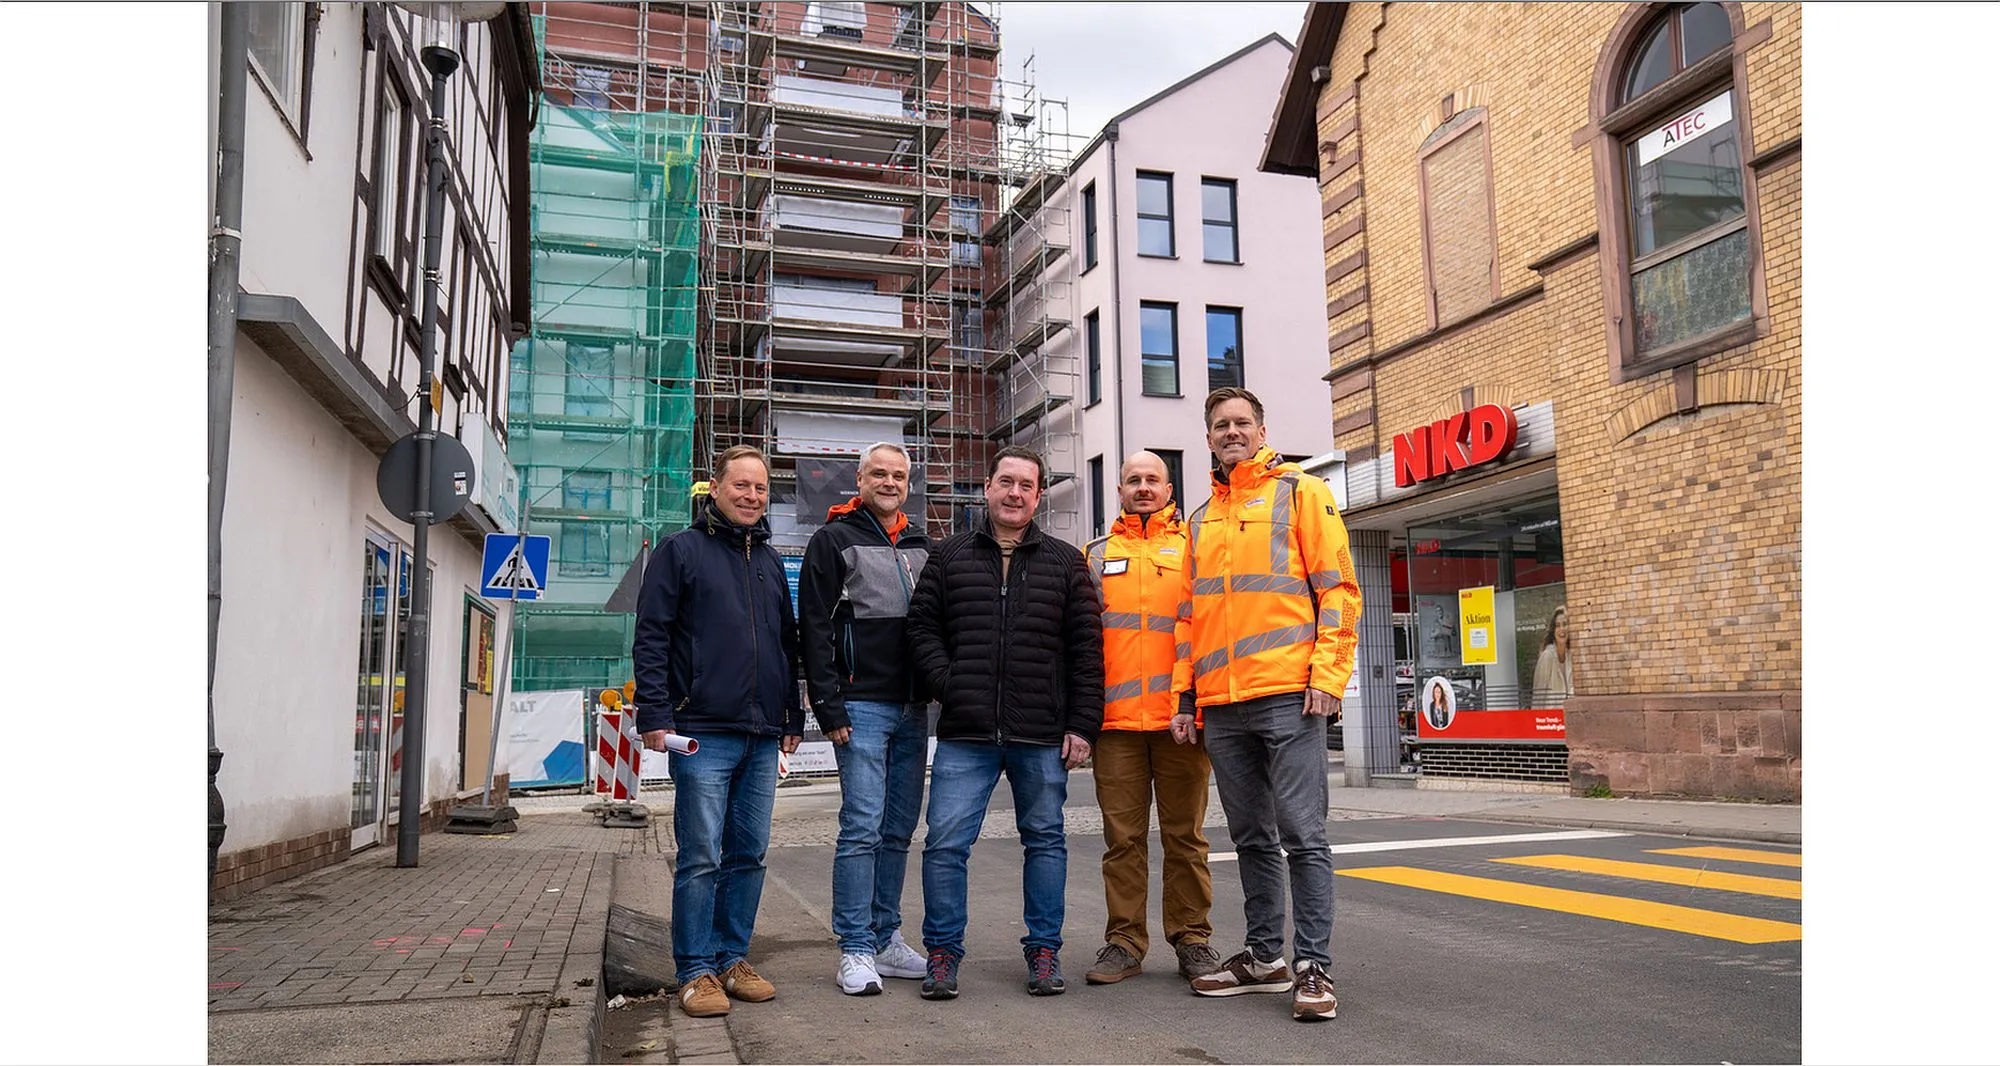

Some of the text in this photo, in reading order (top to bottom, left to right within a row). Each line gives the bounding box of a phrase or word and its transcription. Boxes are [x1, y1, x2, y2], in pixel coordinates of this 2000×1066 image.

[1662, 111, 1706, 148] ATEC
[1393, 403, 1517, 488] NKD
[1465, 612, 1491, 625] Aktion
